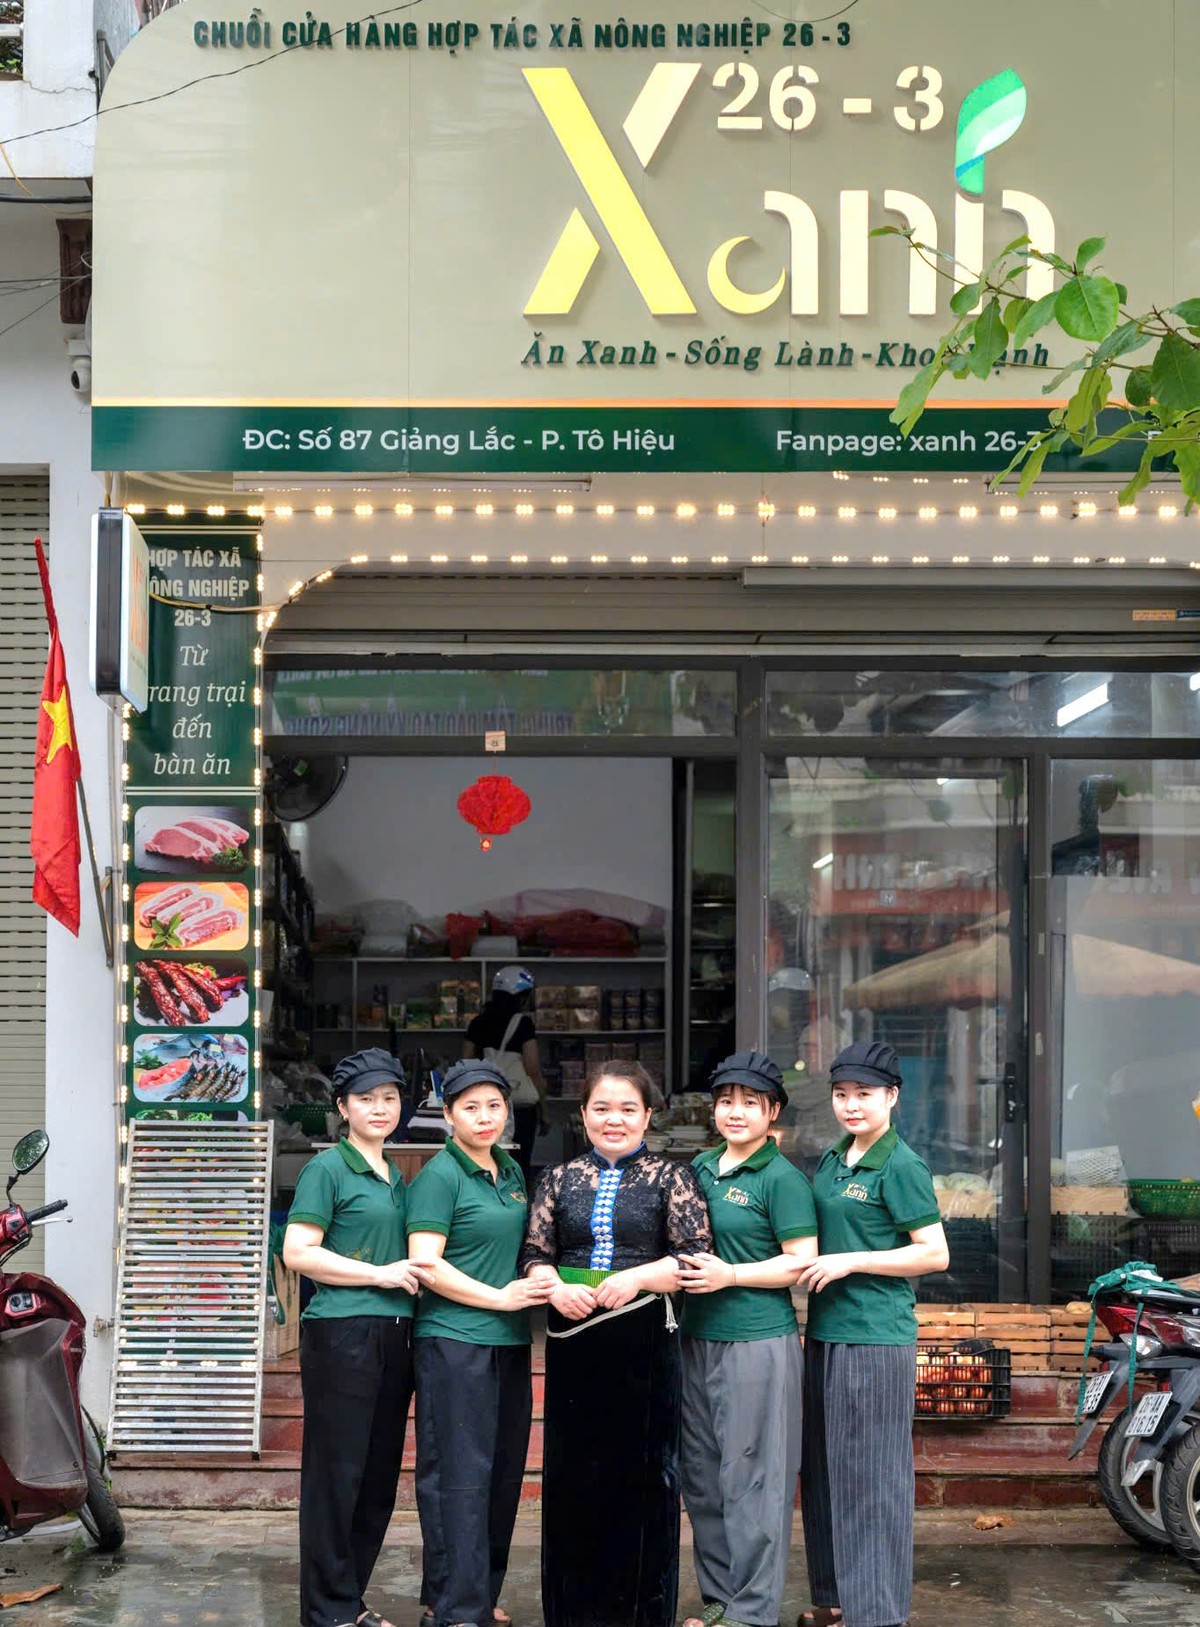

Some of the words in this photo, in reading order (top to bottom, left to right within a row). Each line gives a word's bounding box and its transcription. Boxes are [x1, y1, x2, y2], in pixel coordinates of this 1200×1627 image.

[193, 8, 271, 48] CHUỖI
[282, 11, 333, 48] CỬA
[346, 15, 418, 48] HÀNG
[428, 20, 479, 57] HỢP
[490, 16, 538, 48] TÁC
[550, 17, 583, 48] XÃ
[594, 17, 666, 48] NÔNG
[677, 17, 771, 55] NGHIỆP
[521, 62, 1057, 315] Xanh
[520, 331, 565, 365] Ăn
[242, 429, 290, 450] ĐC:
[298, 426, 333, 450] Số
[339, 430, 372, 450] 87
[380, 427, 460, 456] Giảng
[469, 426, 516, 450] Lắc
[542, 430, 565, 450] P.
[572, 429, 605, 450] Tô
[613, 428, 675, 456] Hiệu
[776, 430, 903, 456] Fanpage:
[909, 430, 976, 451] xanh
[183, 546, 214, 567] TÁC
[219, 546, 242, 567] XÃ
[149, 575, 183, 597] ÔNG
[188, 576, 250, 601] NGHIỆP
[174, 609, 212, 627] 26-3
[180, 644, 209, 666] Từ
[148, 685, 200, 707] rang
[206, 680, 246, 708] trại
[172, 713, 212, 739] đến
[153, 753, 196, 775] bàn
[202, 753, 231, 775] ăn
